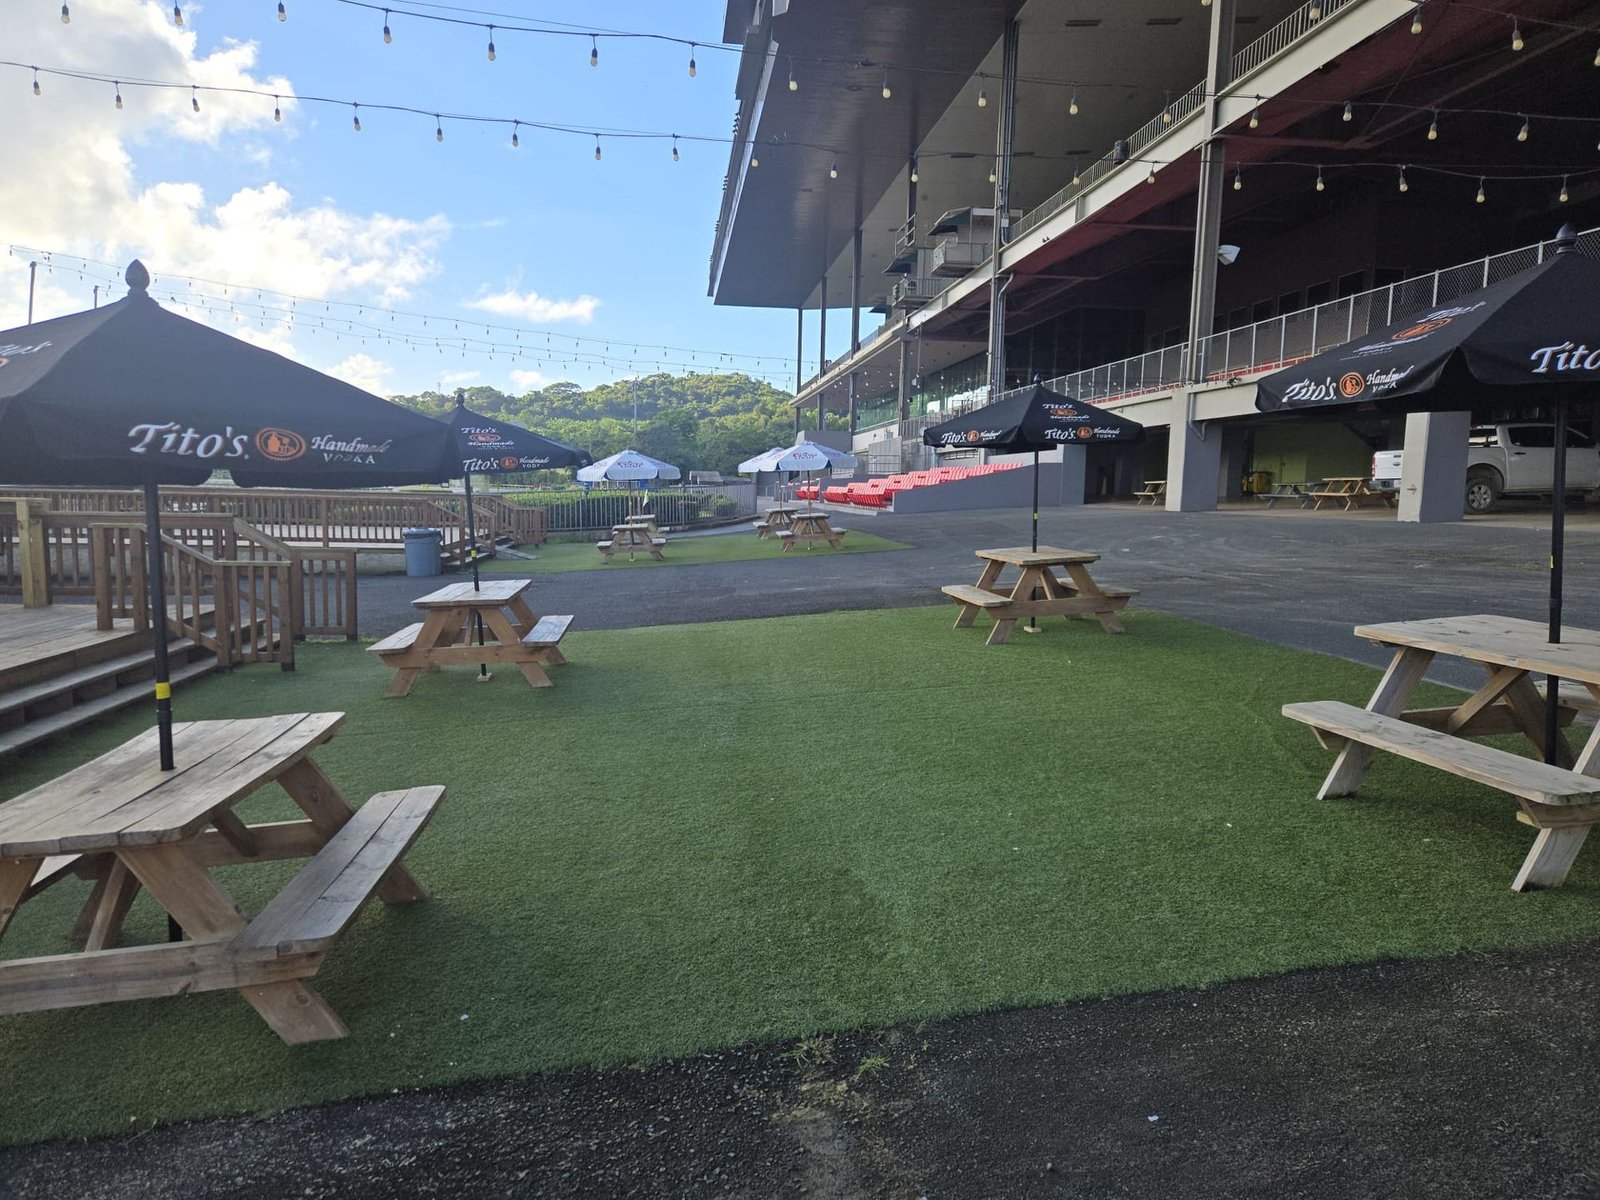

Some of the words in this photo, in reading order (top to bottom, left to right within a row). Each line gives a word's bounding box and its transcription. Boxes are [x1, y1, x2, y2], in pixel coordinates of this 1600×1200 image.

[1282, 378, 1337, 402] Tito's
[128, 421, 250, 459] Tito's
[940, 431, 967, 444] Tito's
[1044, 428, 1077, 440] Tito's
[462, 457, 500, 472] Tito's
